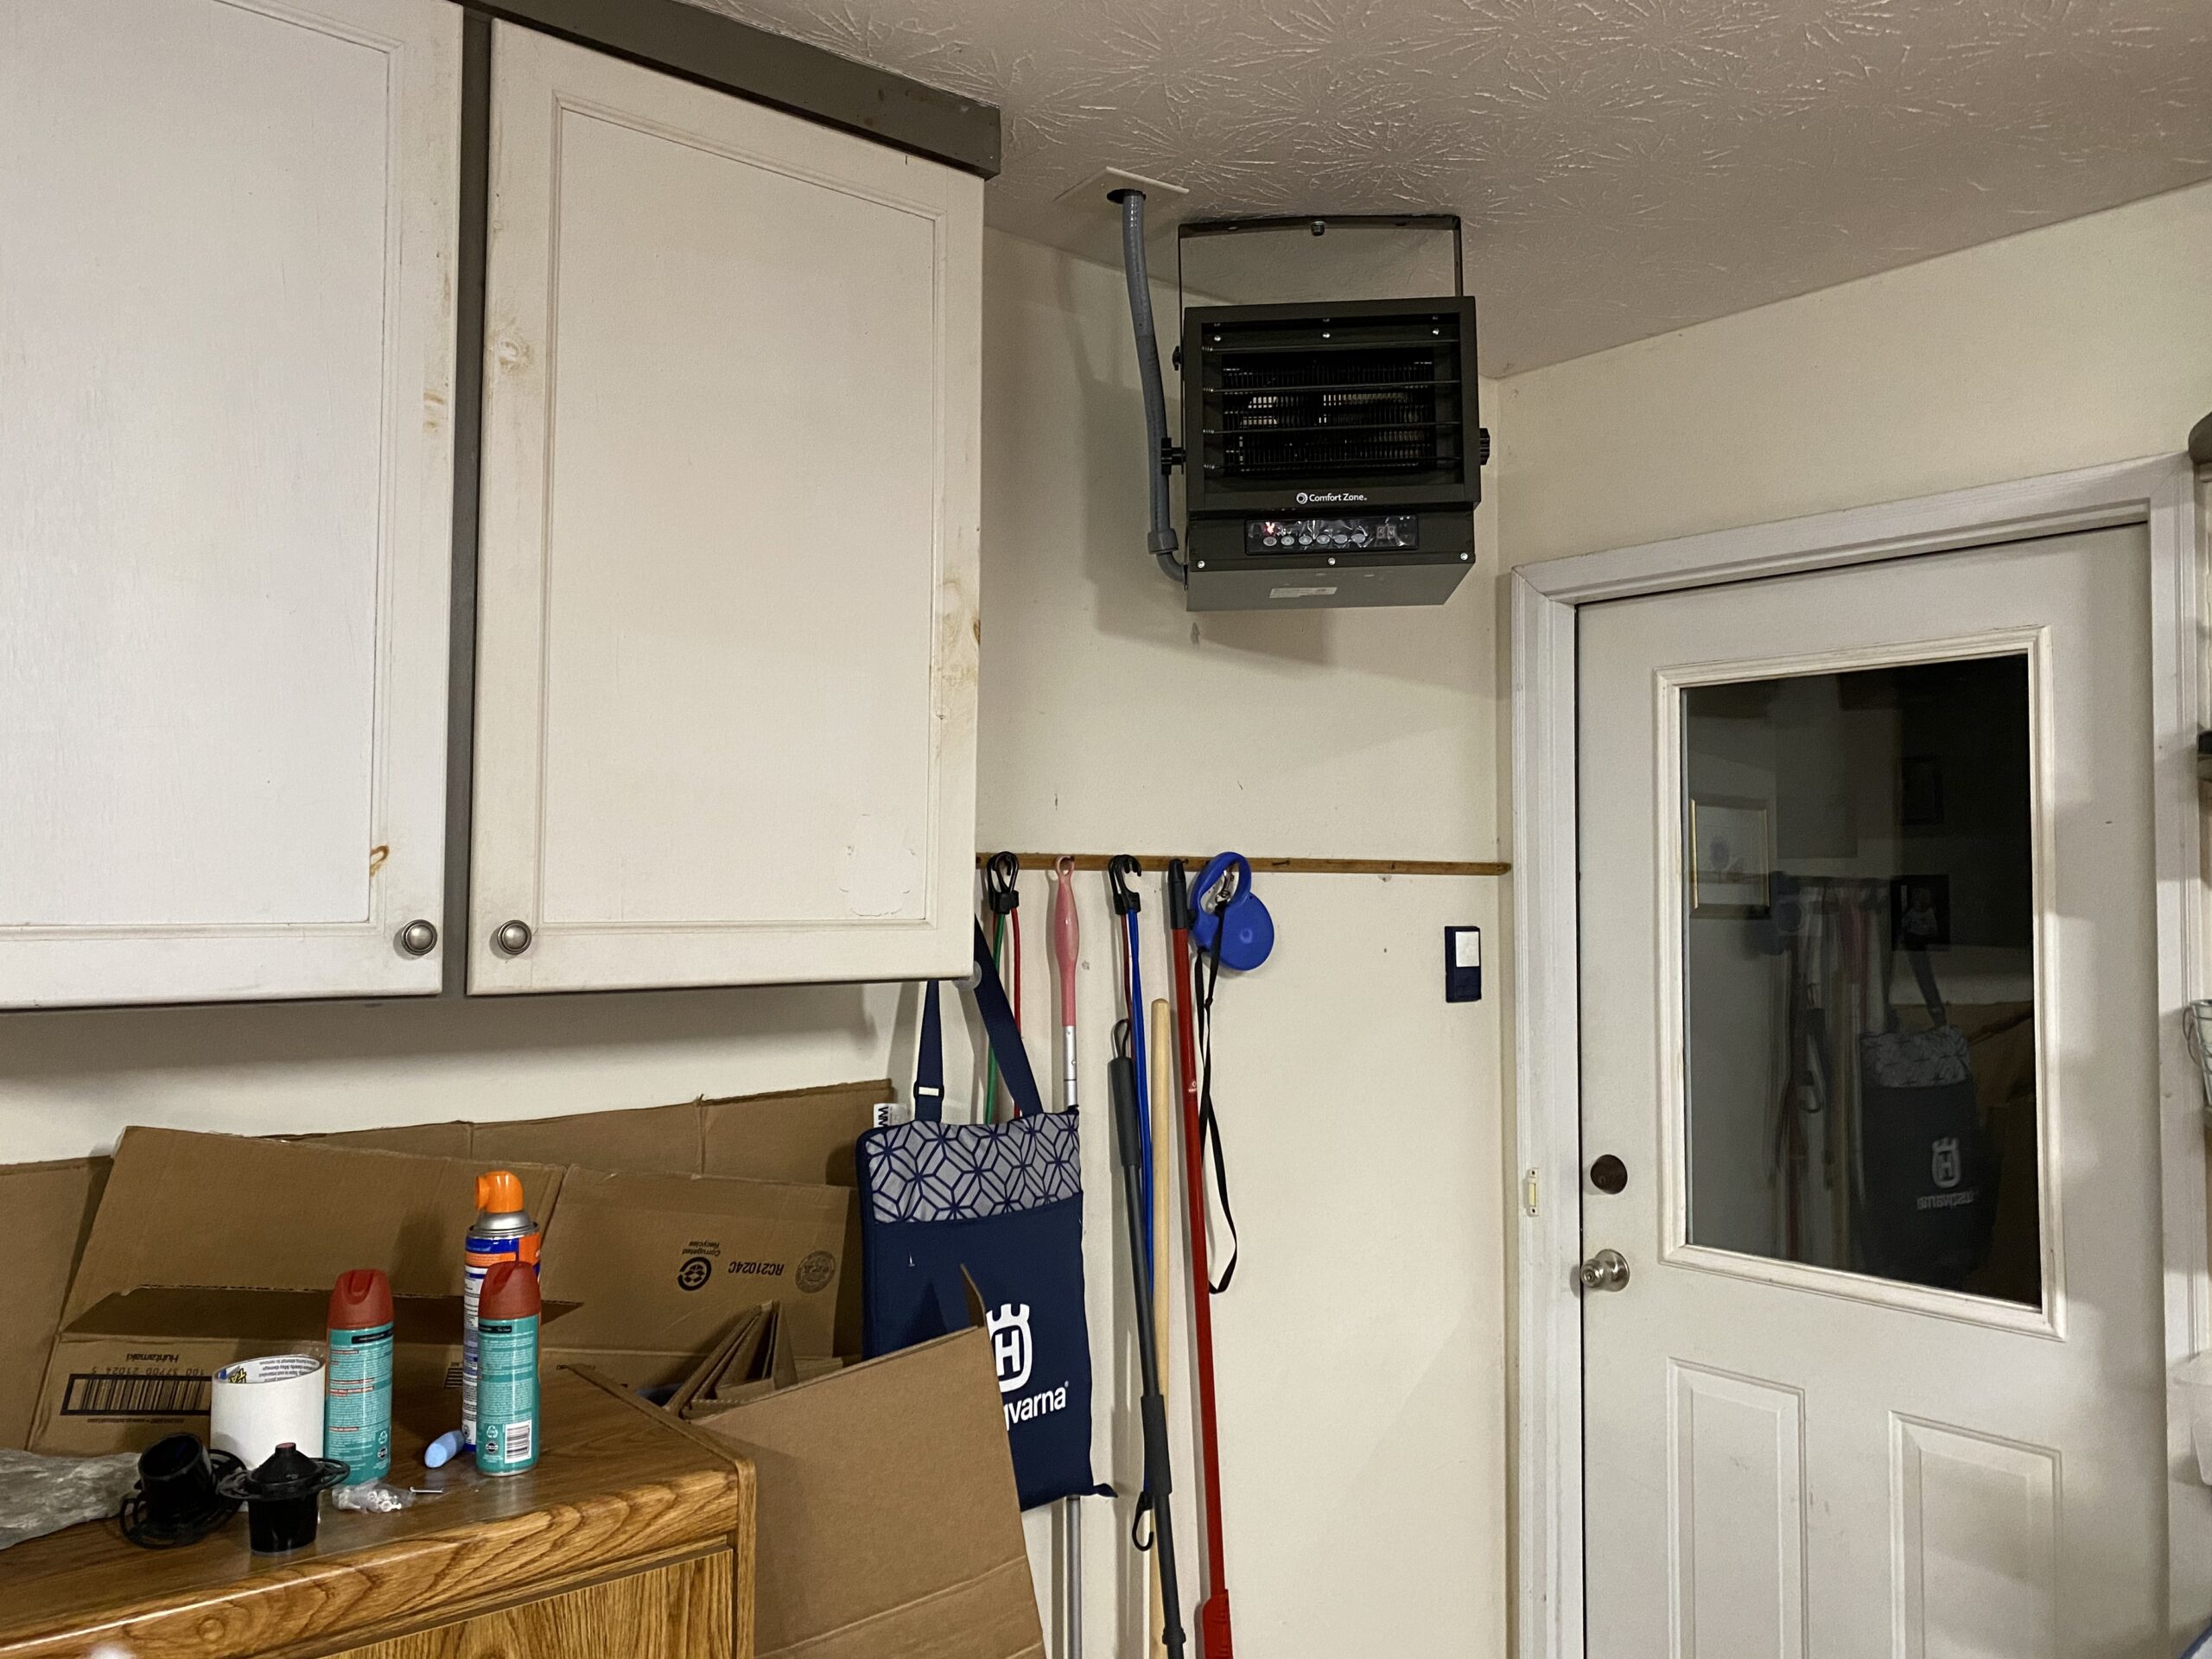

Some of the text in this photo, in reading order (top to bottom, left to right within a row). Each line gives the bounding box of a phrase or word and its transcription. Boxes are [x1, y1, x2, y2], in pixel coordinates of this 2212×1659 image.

[1309, 493, 1341, 502] Comfort
[682, 1249, 721, 1257] Corrugated
[728, 1261, 785, 1276] RC21024C
[995, 1329, 1021, 1377] H
[1003, 1386, 1066, 1432] varna
